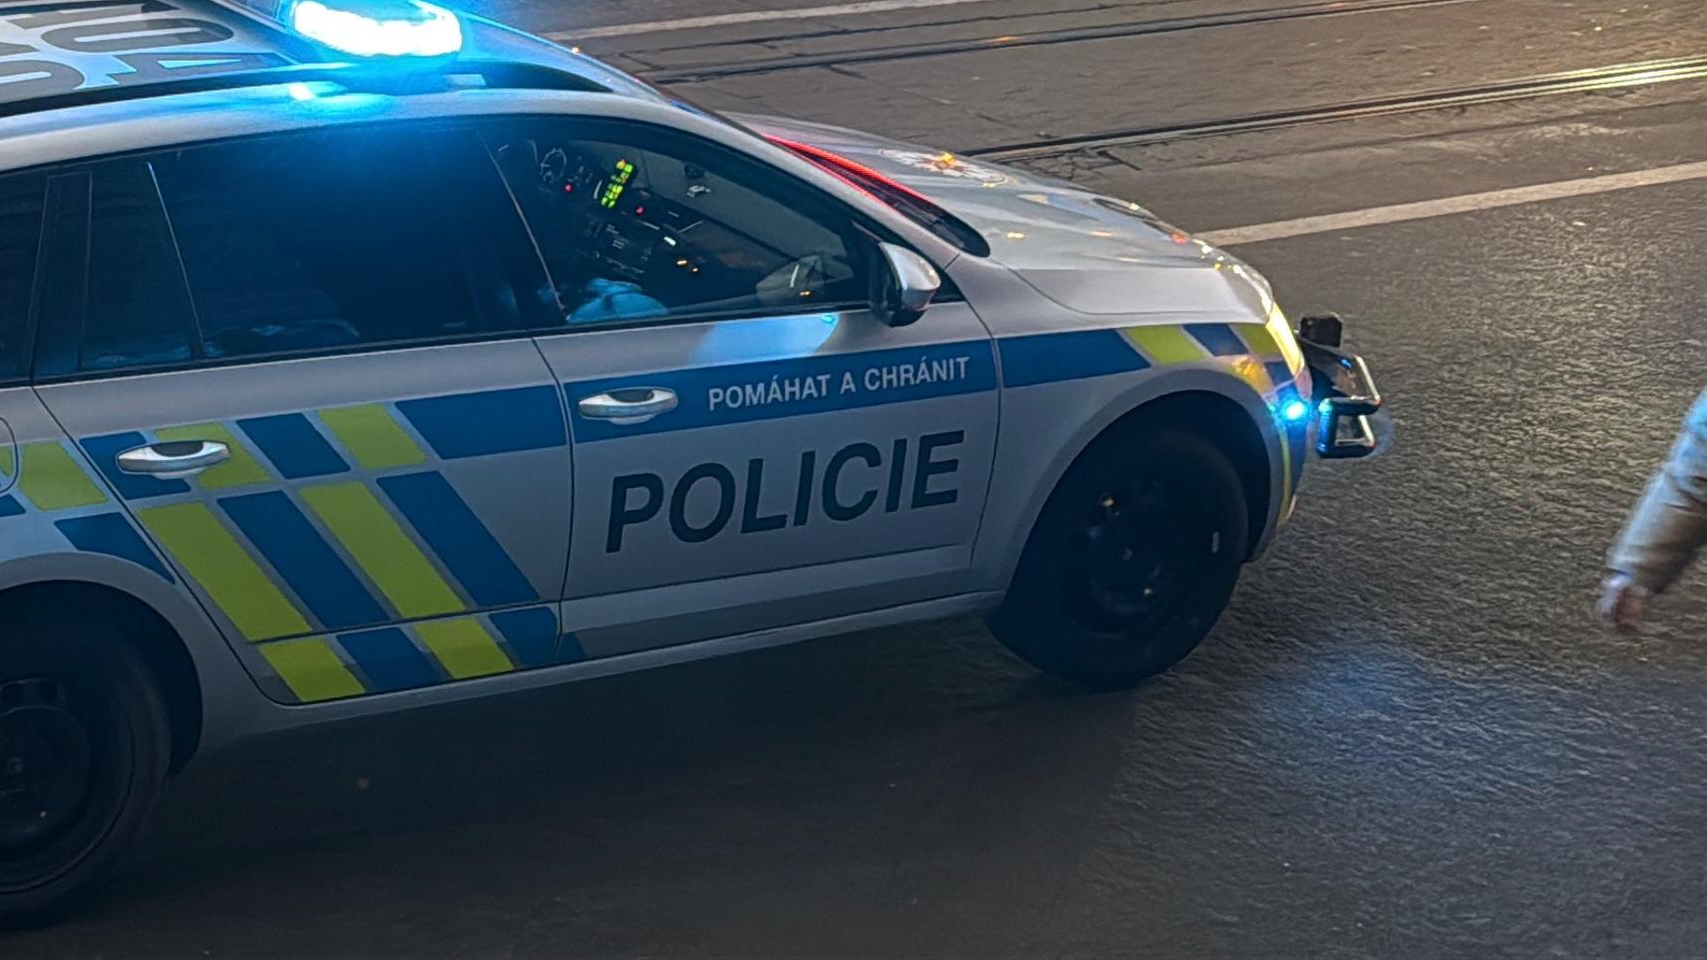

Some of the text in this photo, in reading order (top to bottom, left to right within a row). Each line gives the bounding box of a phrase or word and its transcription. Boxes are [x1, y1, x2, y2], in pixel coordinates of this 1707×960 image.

[707, 355, 970, 412] POMÁHAT A CHRÁNIT
[605, 429, 965, 554] POLICIE
